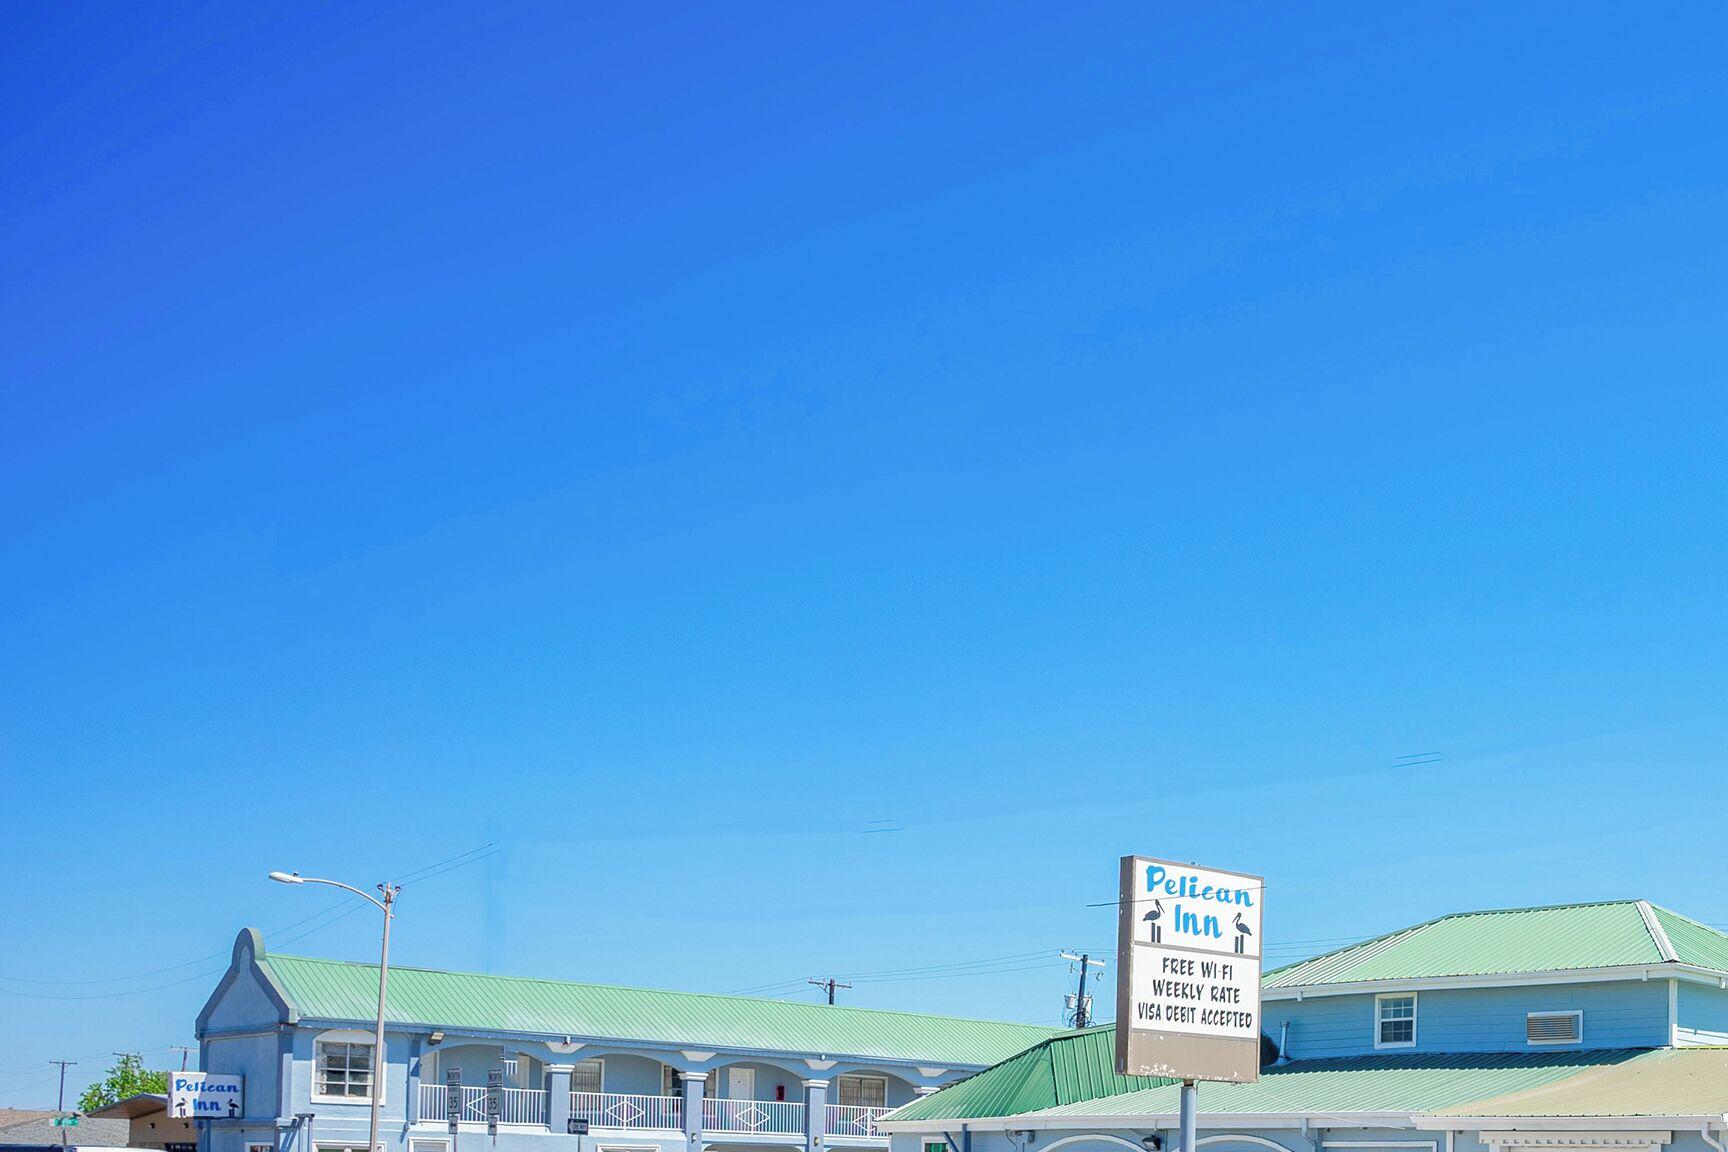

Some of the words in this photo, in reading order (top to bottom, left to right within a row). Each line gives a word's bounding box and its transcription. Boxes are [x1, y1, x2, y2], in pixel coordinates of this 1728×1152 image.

[1145, 865, 1254, 907] Pelican
[1174, 904, 1222, 938] Inn
[1162, 957, 1195, 976] FREE
[1201, 961, 1233, 980] WI-FI
[1152, 979, 1204, 1000] WEEKLY
[1211, 985, 1240, 1004] RATE
[1138, 1002, 1162, 1021] VISA
[1166, 1005, 1196, 1023] DEBIT
[1201, 1008, 1252, 1028] ACCEPTED
[175, 1078, 239, 1093] Pelican
[193, 1098, 221, 1111] Inn
[449, 1096, 458, 1109] 35
[489, 1097, 497, 1110] 35
